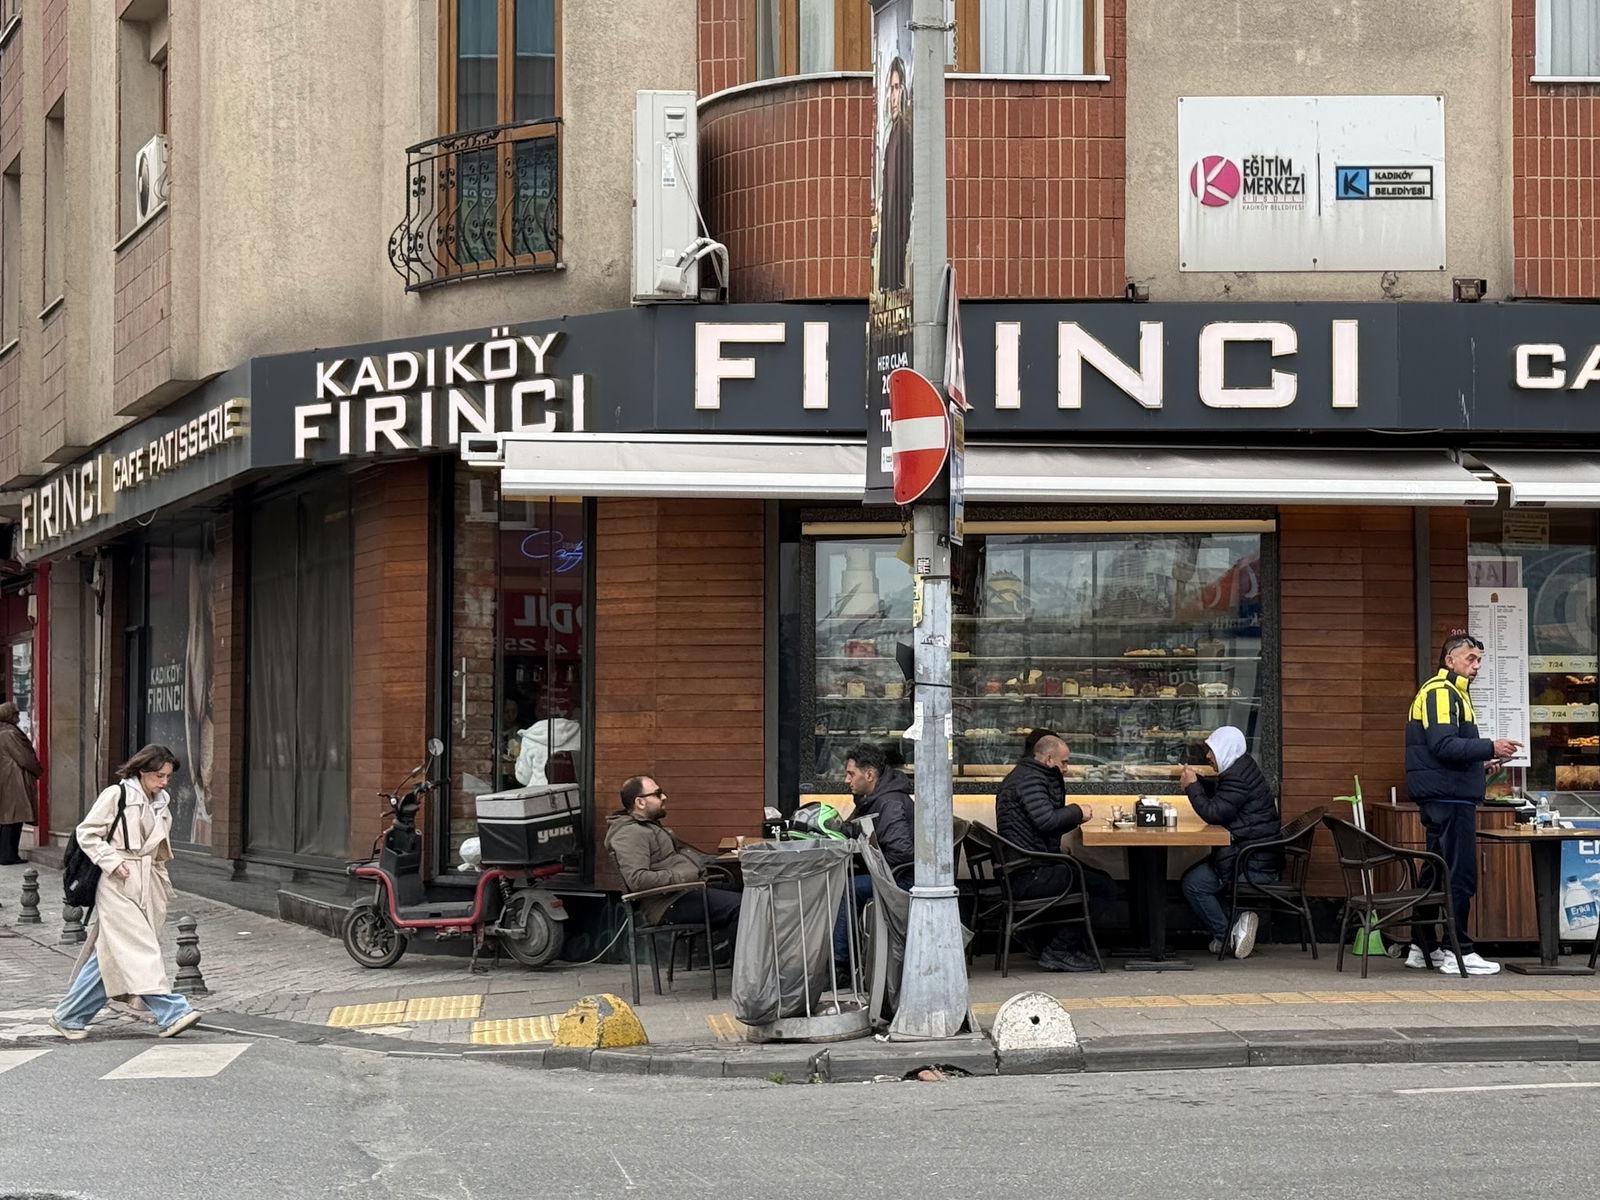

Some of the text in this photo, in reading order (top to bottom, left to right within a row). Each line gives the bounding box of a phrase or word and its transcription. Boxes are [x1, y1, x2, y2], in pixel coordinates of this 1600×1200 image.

[1242, 154, 1292, 177] EĞİTİM
[1242, 173, 1305, 195] MERKEZİ
[1375, 170, 1414, 180] KADIKÖY
[1375, 186, 1426, 195] BELEDİYESİ
[316, 327, 567, 399] KADIKÖY
[695, 321, 1358, 409] FIINCI
[878, 356, 889, 371] HER
[294, 373, 586, 459] FIRINCI
[21, 399, 238, 549] FIRINCI CAFE PATISSERIE
[1548, 660, 1563, 668] 7/24
[148, 685, 184, 714] FIRINCI
[1551, 710, 1567, 718] 7/24
[1146, 814, 1156, 822] 24
[771, 825, 781, 834] 25
